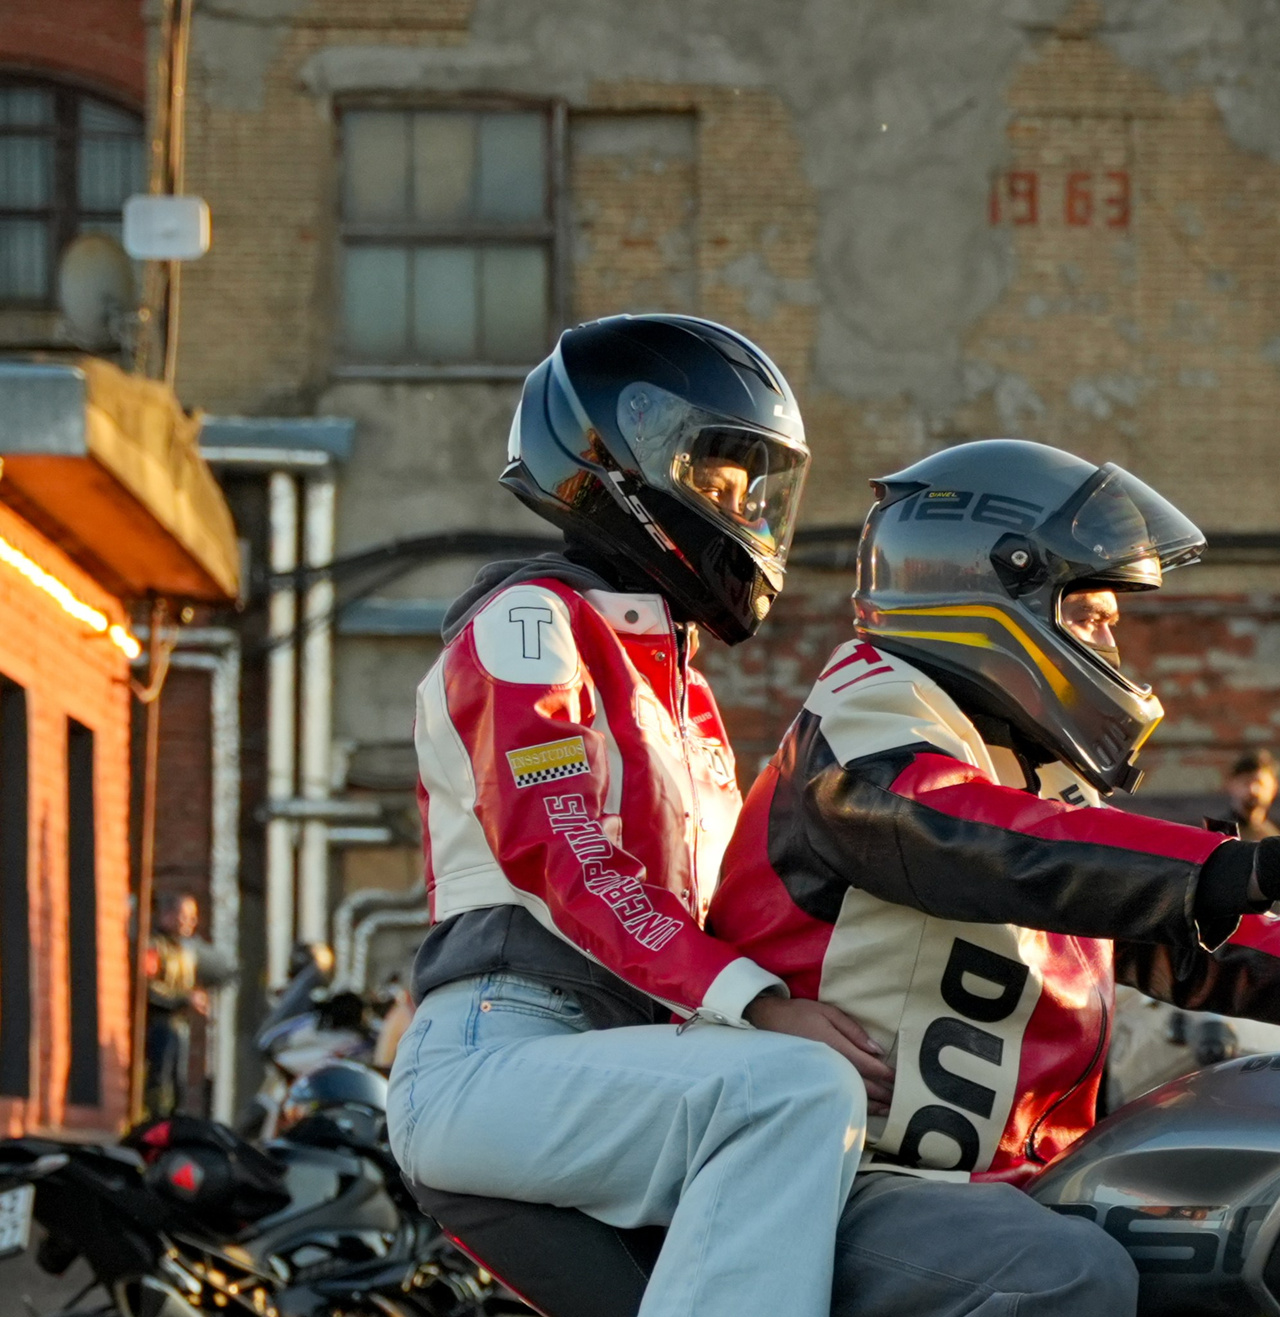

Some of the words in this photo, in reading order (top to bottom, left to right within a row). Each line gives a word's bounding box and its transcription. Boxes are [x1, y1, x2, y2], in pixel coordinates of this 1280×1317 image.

[988, 170, 1131, 227] 1963
[608, 471, 676, 552] LS2
[509, 607, 552, 659] T
[510, 744, 585, 769] INSSTUDIOS
[871, 937, 1029, 1170] DUC
